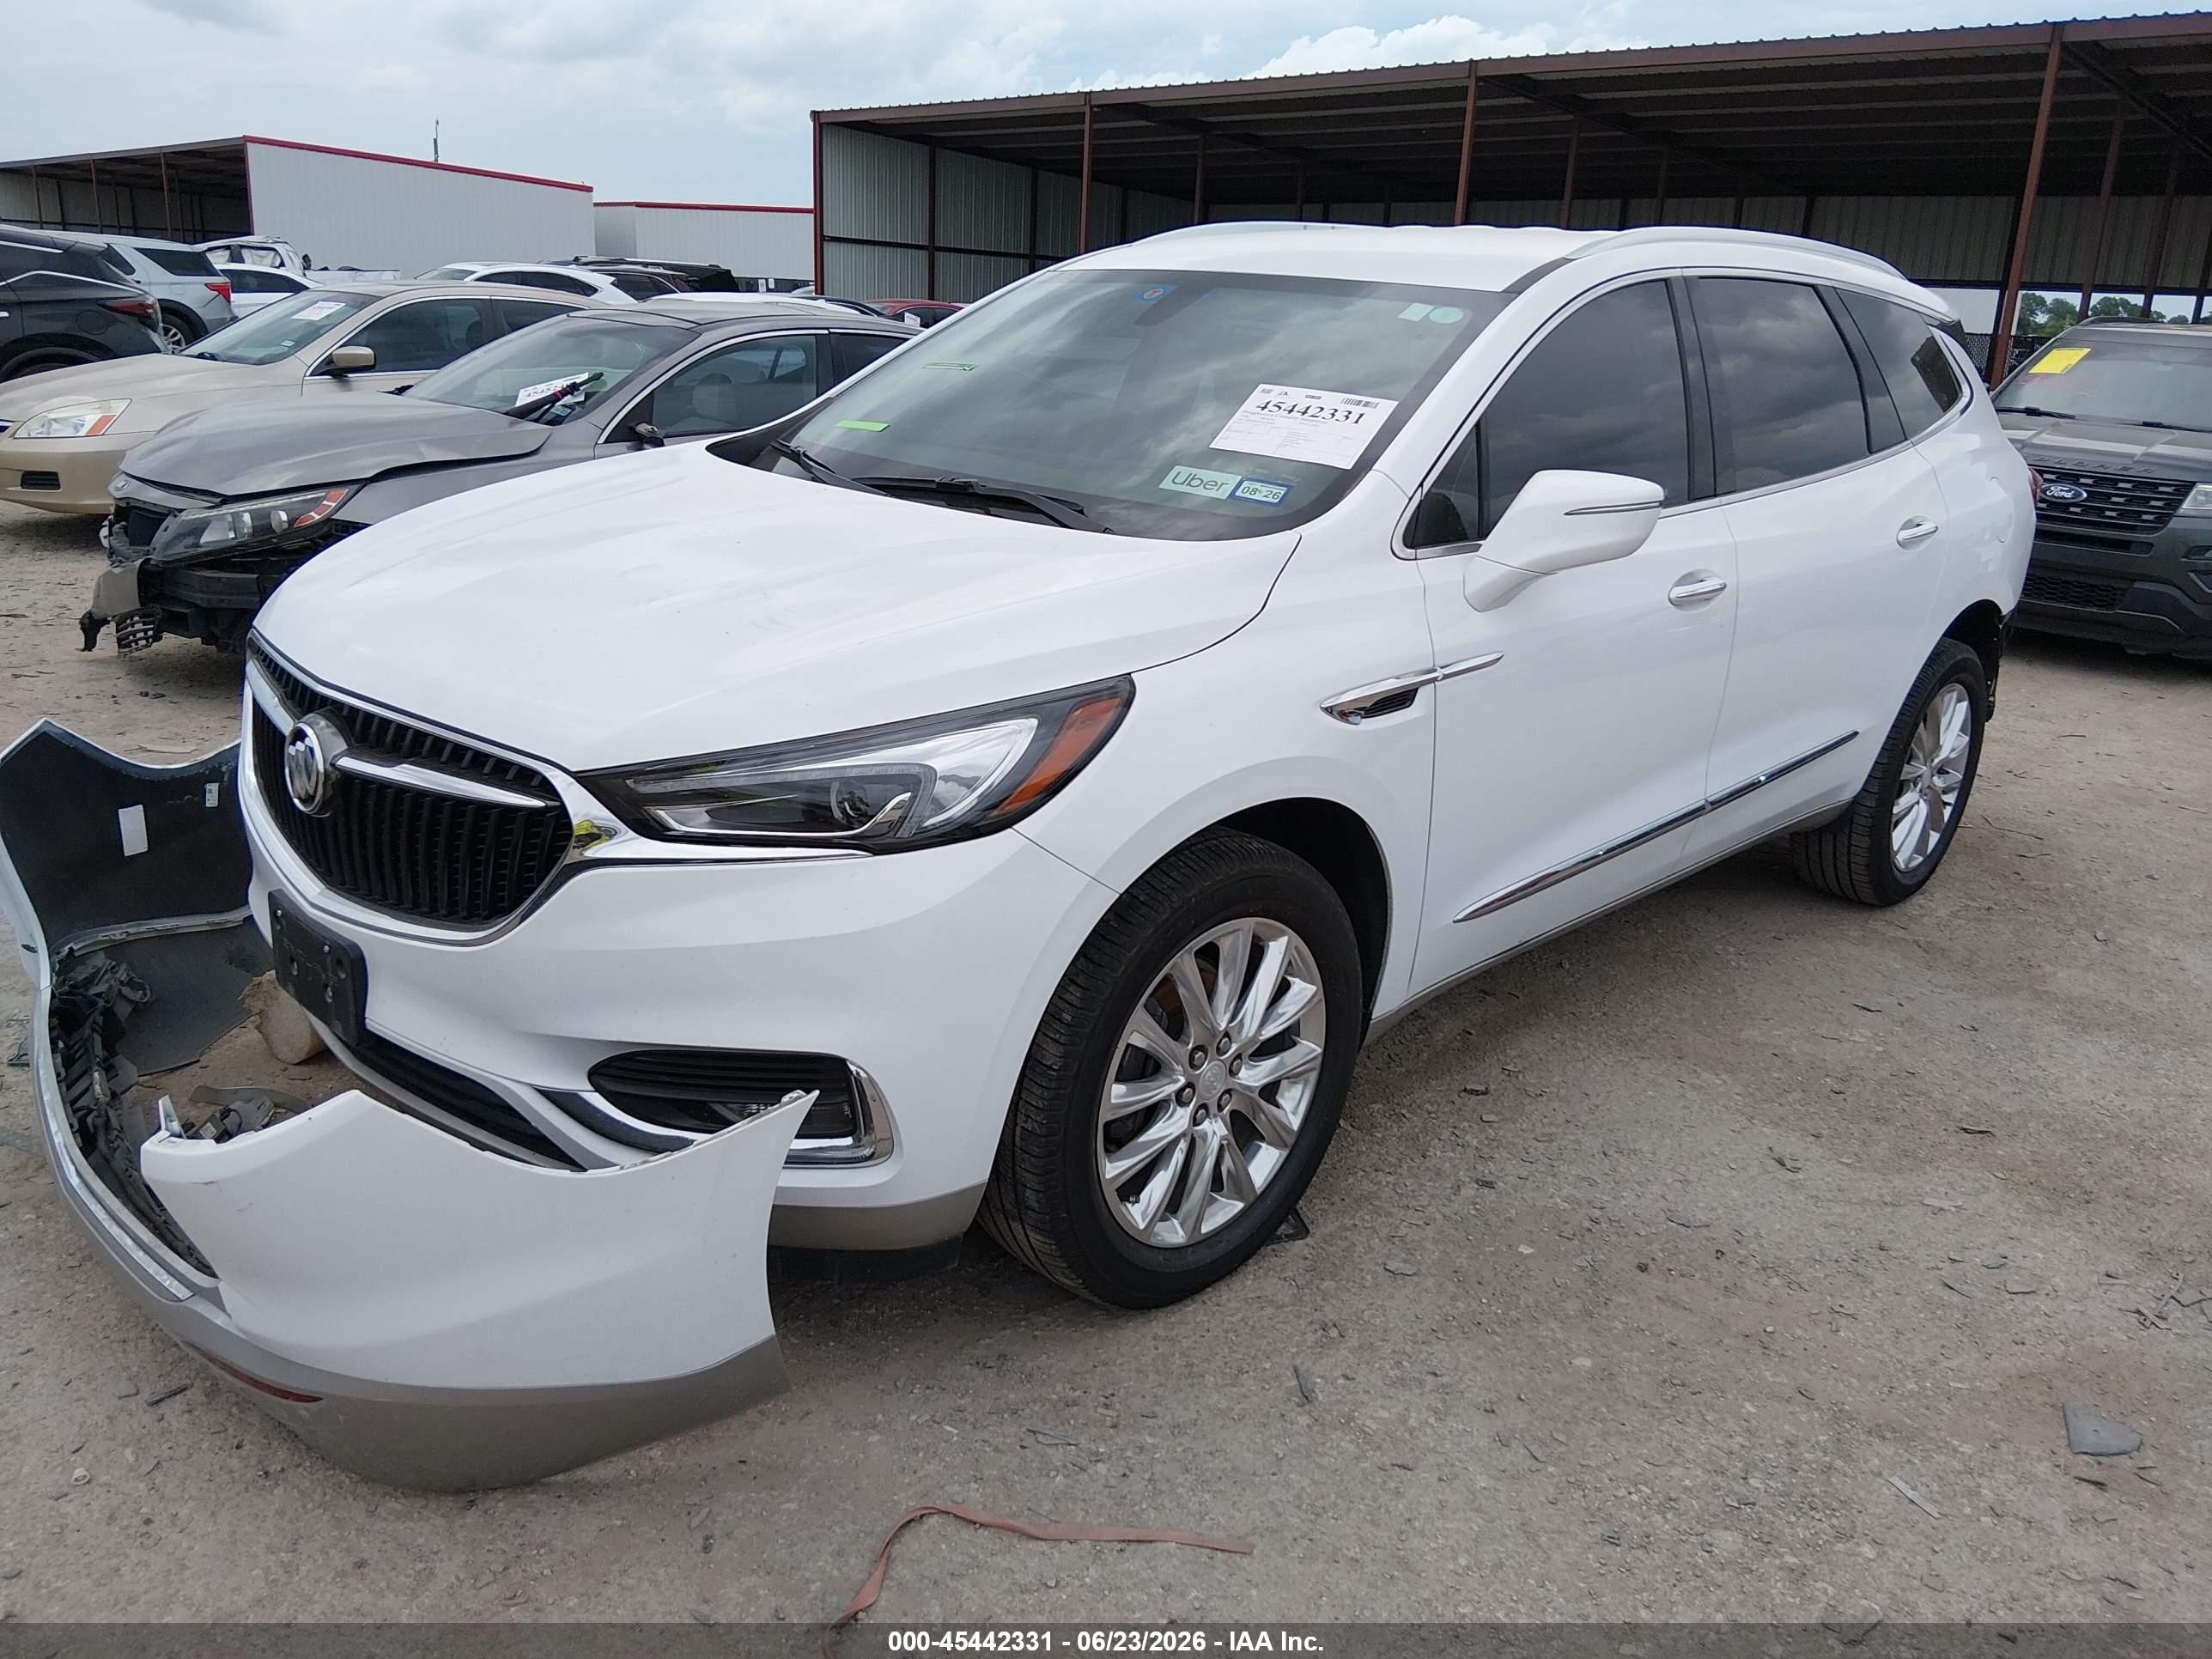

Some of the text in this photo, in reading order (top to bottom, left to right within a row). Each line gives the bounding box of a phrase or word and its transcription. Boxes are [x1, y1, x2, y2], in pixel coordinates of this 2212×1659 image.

[1255, 399, 1366, 424] 45442331
[1170, 471, 1230, 492] Uber
[2045, 485, 2075, 499] Ford
